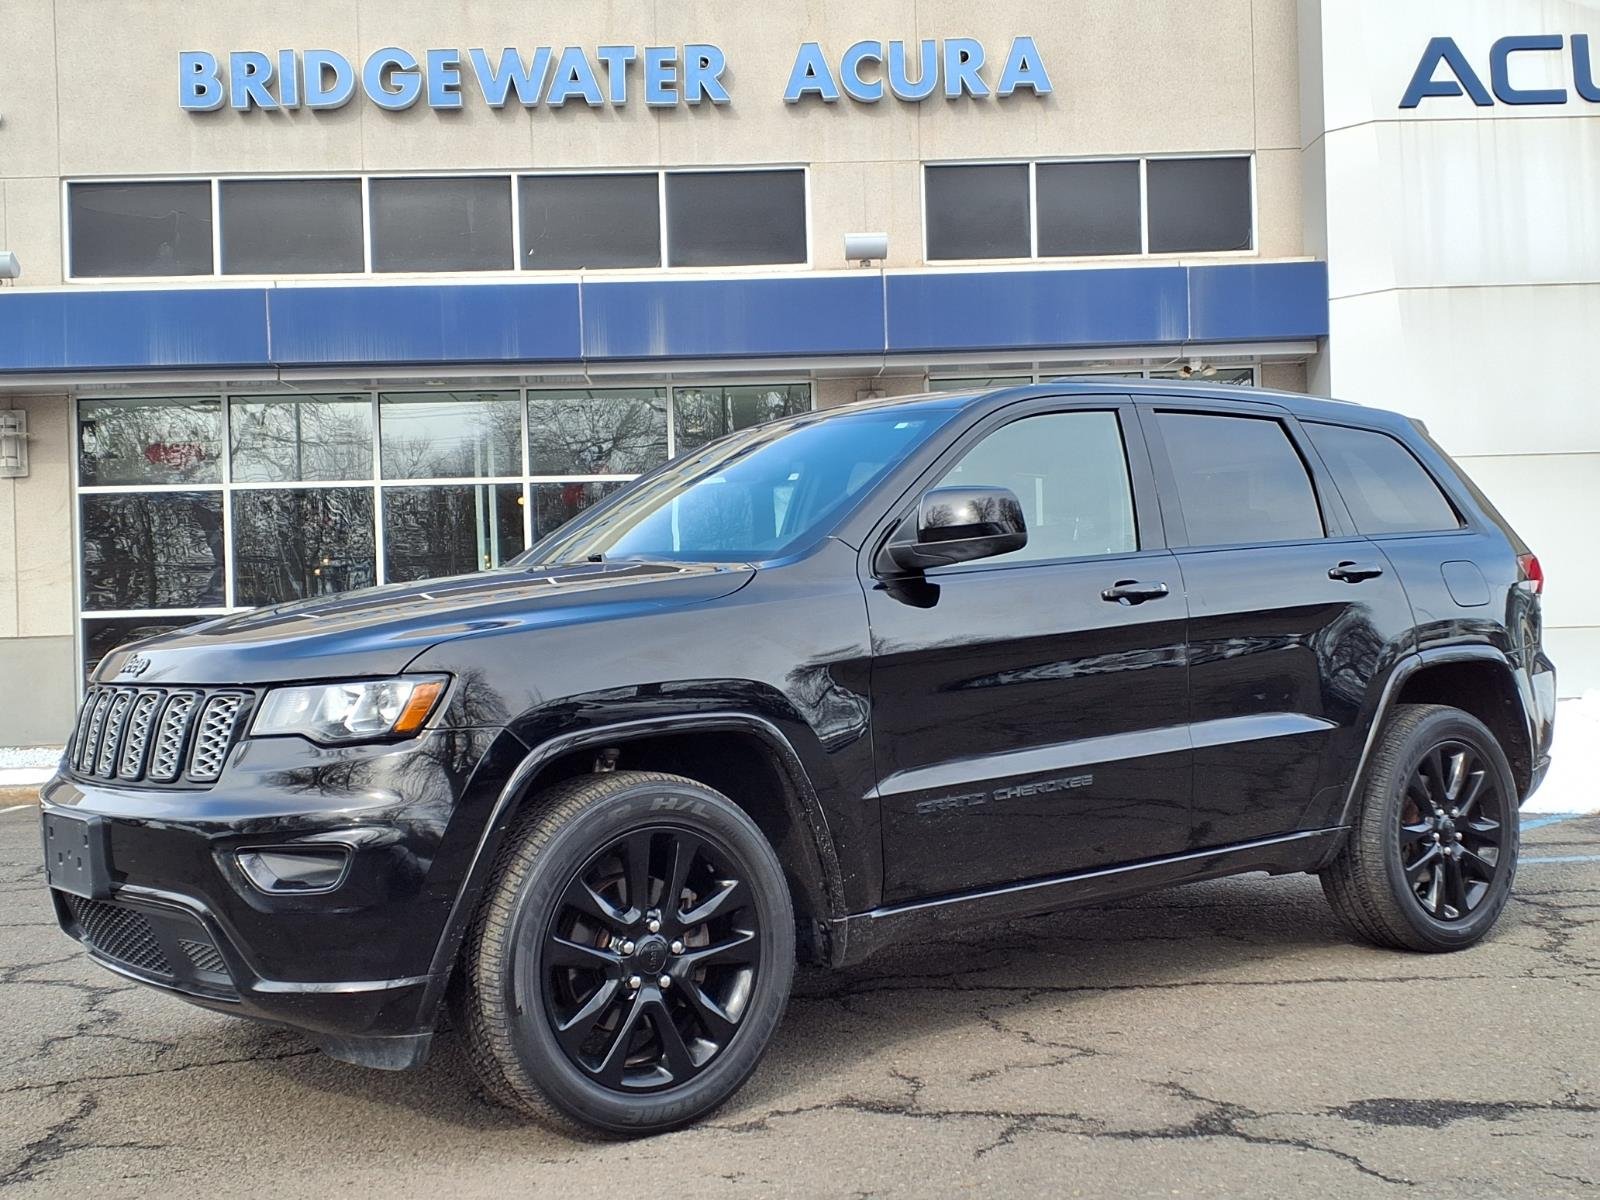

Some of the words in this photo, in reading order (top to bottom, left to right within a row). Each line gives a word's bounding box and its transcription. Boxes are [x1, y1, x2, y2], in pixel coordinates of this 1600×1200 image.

[178, 44, 731, 113] BRIDGEWATER
[783, 36, 1054, 105] ACURA
[992, 774, 1094, 801] CHEROKEE
